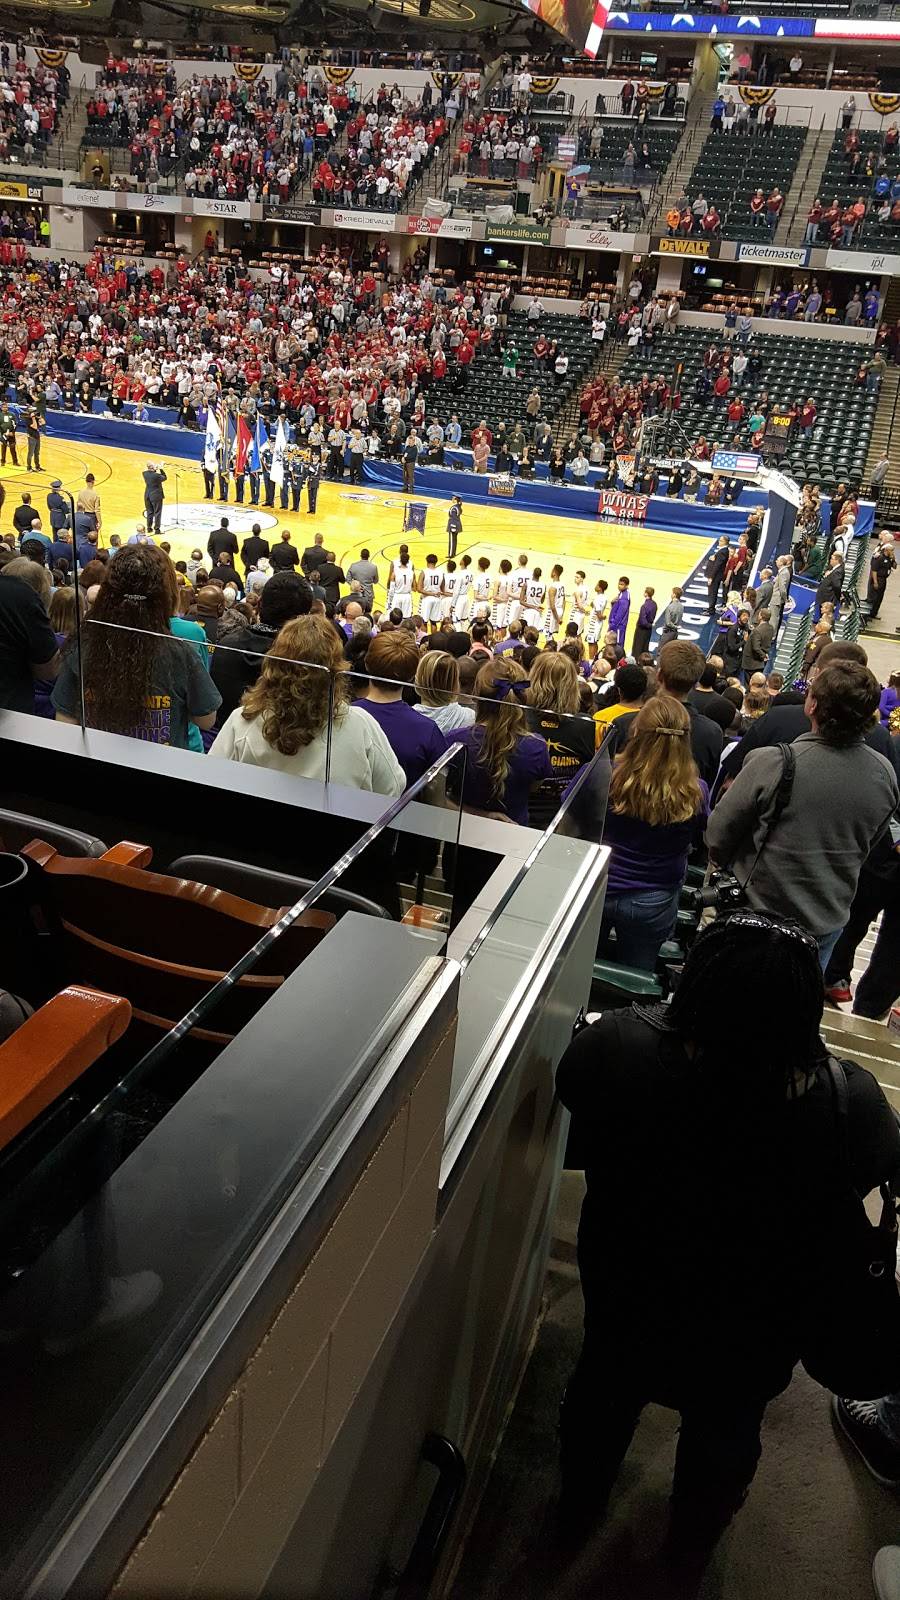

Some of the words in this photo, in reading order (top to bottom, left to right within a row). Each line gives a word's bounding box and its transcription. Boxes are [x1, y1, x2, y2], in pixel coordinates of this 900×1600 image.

[28, 187, 42, 198] CAT
[213, 202, 237, 213] STAR
[487, 226, 550, 240] bankerslife.com
[586, 232, 612, 249] Lilly
[741, 245, 805, 261] ticketmaster
[870, 256, 885, 271] ipl
[602, 492, 647, 511] WNAS
[429, 575, 440, 586] 10
[530, 586, 543, 598] 32
[551, 755, 581, 767] GIANTS
